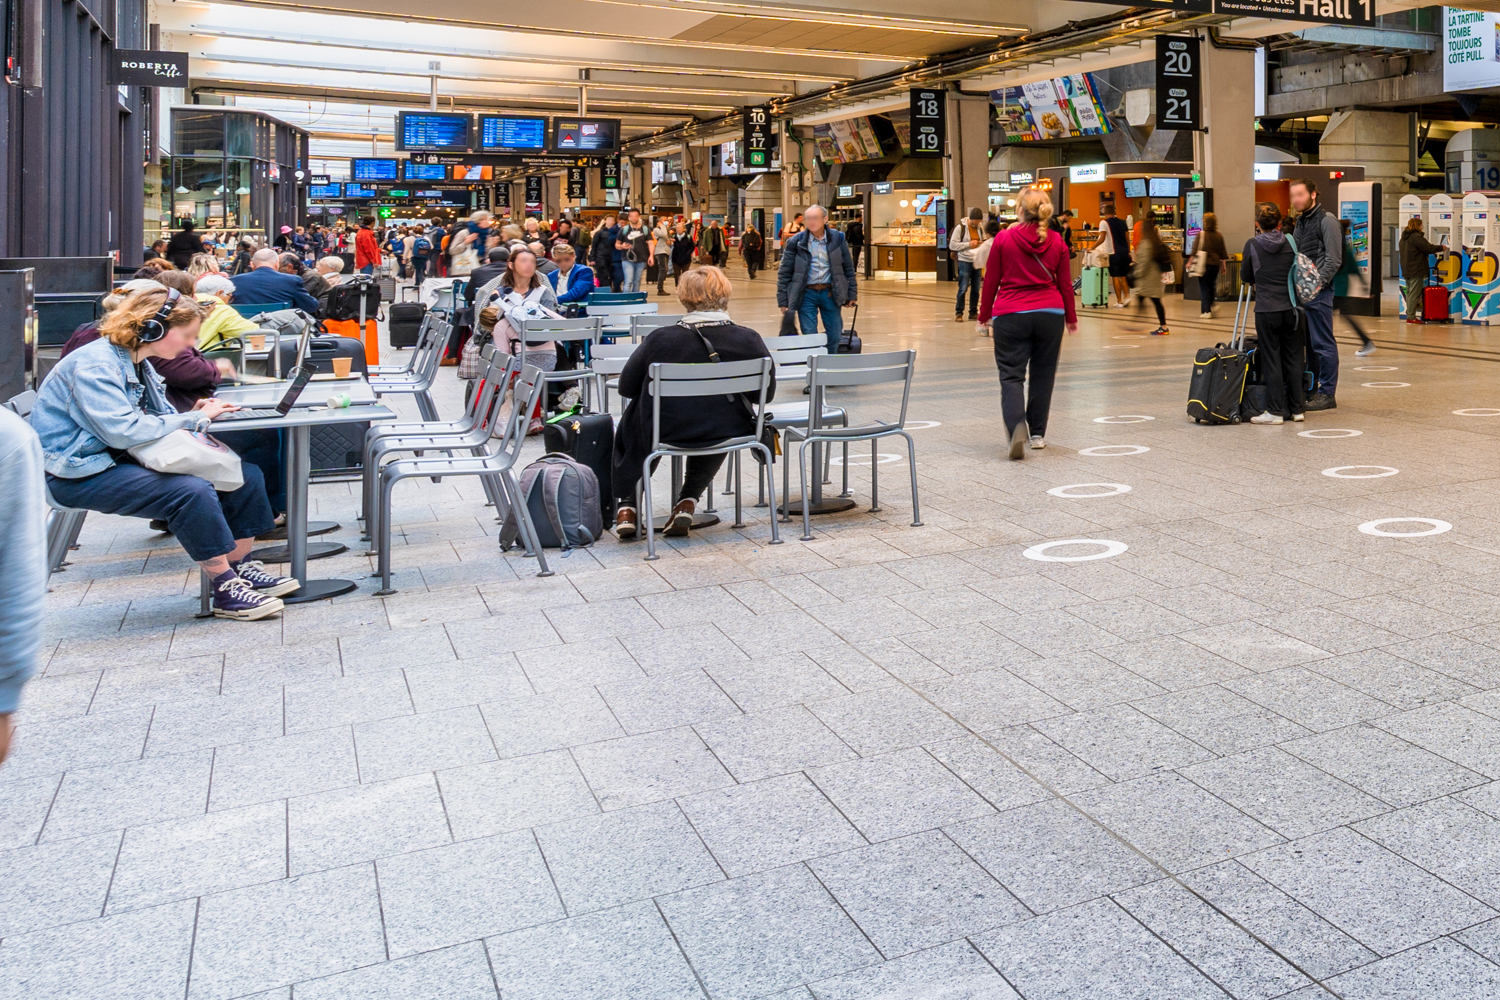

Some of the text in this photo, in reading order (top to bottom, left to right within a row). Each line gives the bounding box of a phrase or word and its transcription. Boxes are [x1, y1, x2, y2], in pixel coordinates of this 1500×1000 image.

[1449, 12, 1485, 27] LA TARTINE
[1448, 26, 1472, 39] TOMBE
[1448, 37, 1482, 52] TOUJOURS
[1164, 51, 1192, 73] 20
[1449, 50, 1485, 64] CÔTÉ PULL.
[122, 61, 178, 70] ROBERTA
[917, 100, 938, 116] 18
[1166, 98, 1191, 120] 21
[750, 113, 766, 123] 10
[750, 138, 766, 148] 17
[917, 134, 938, 149] 19
[1477, 167, 1500, 190] 19
